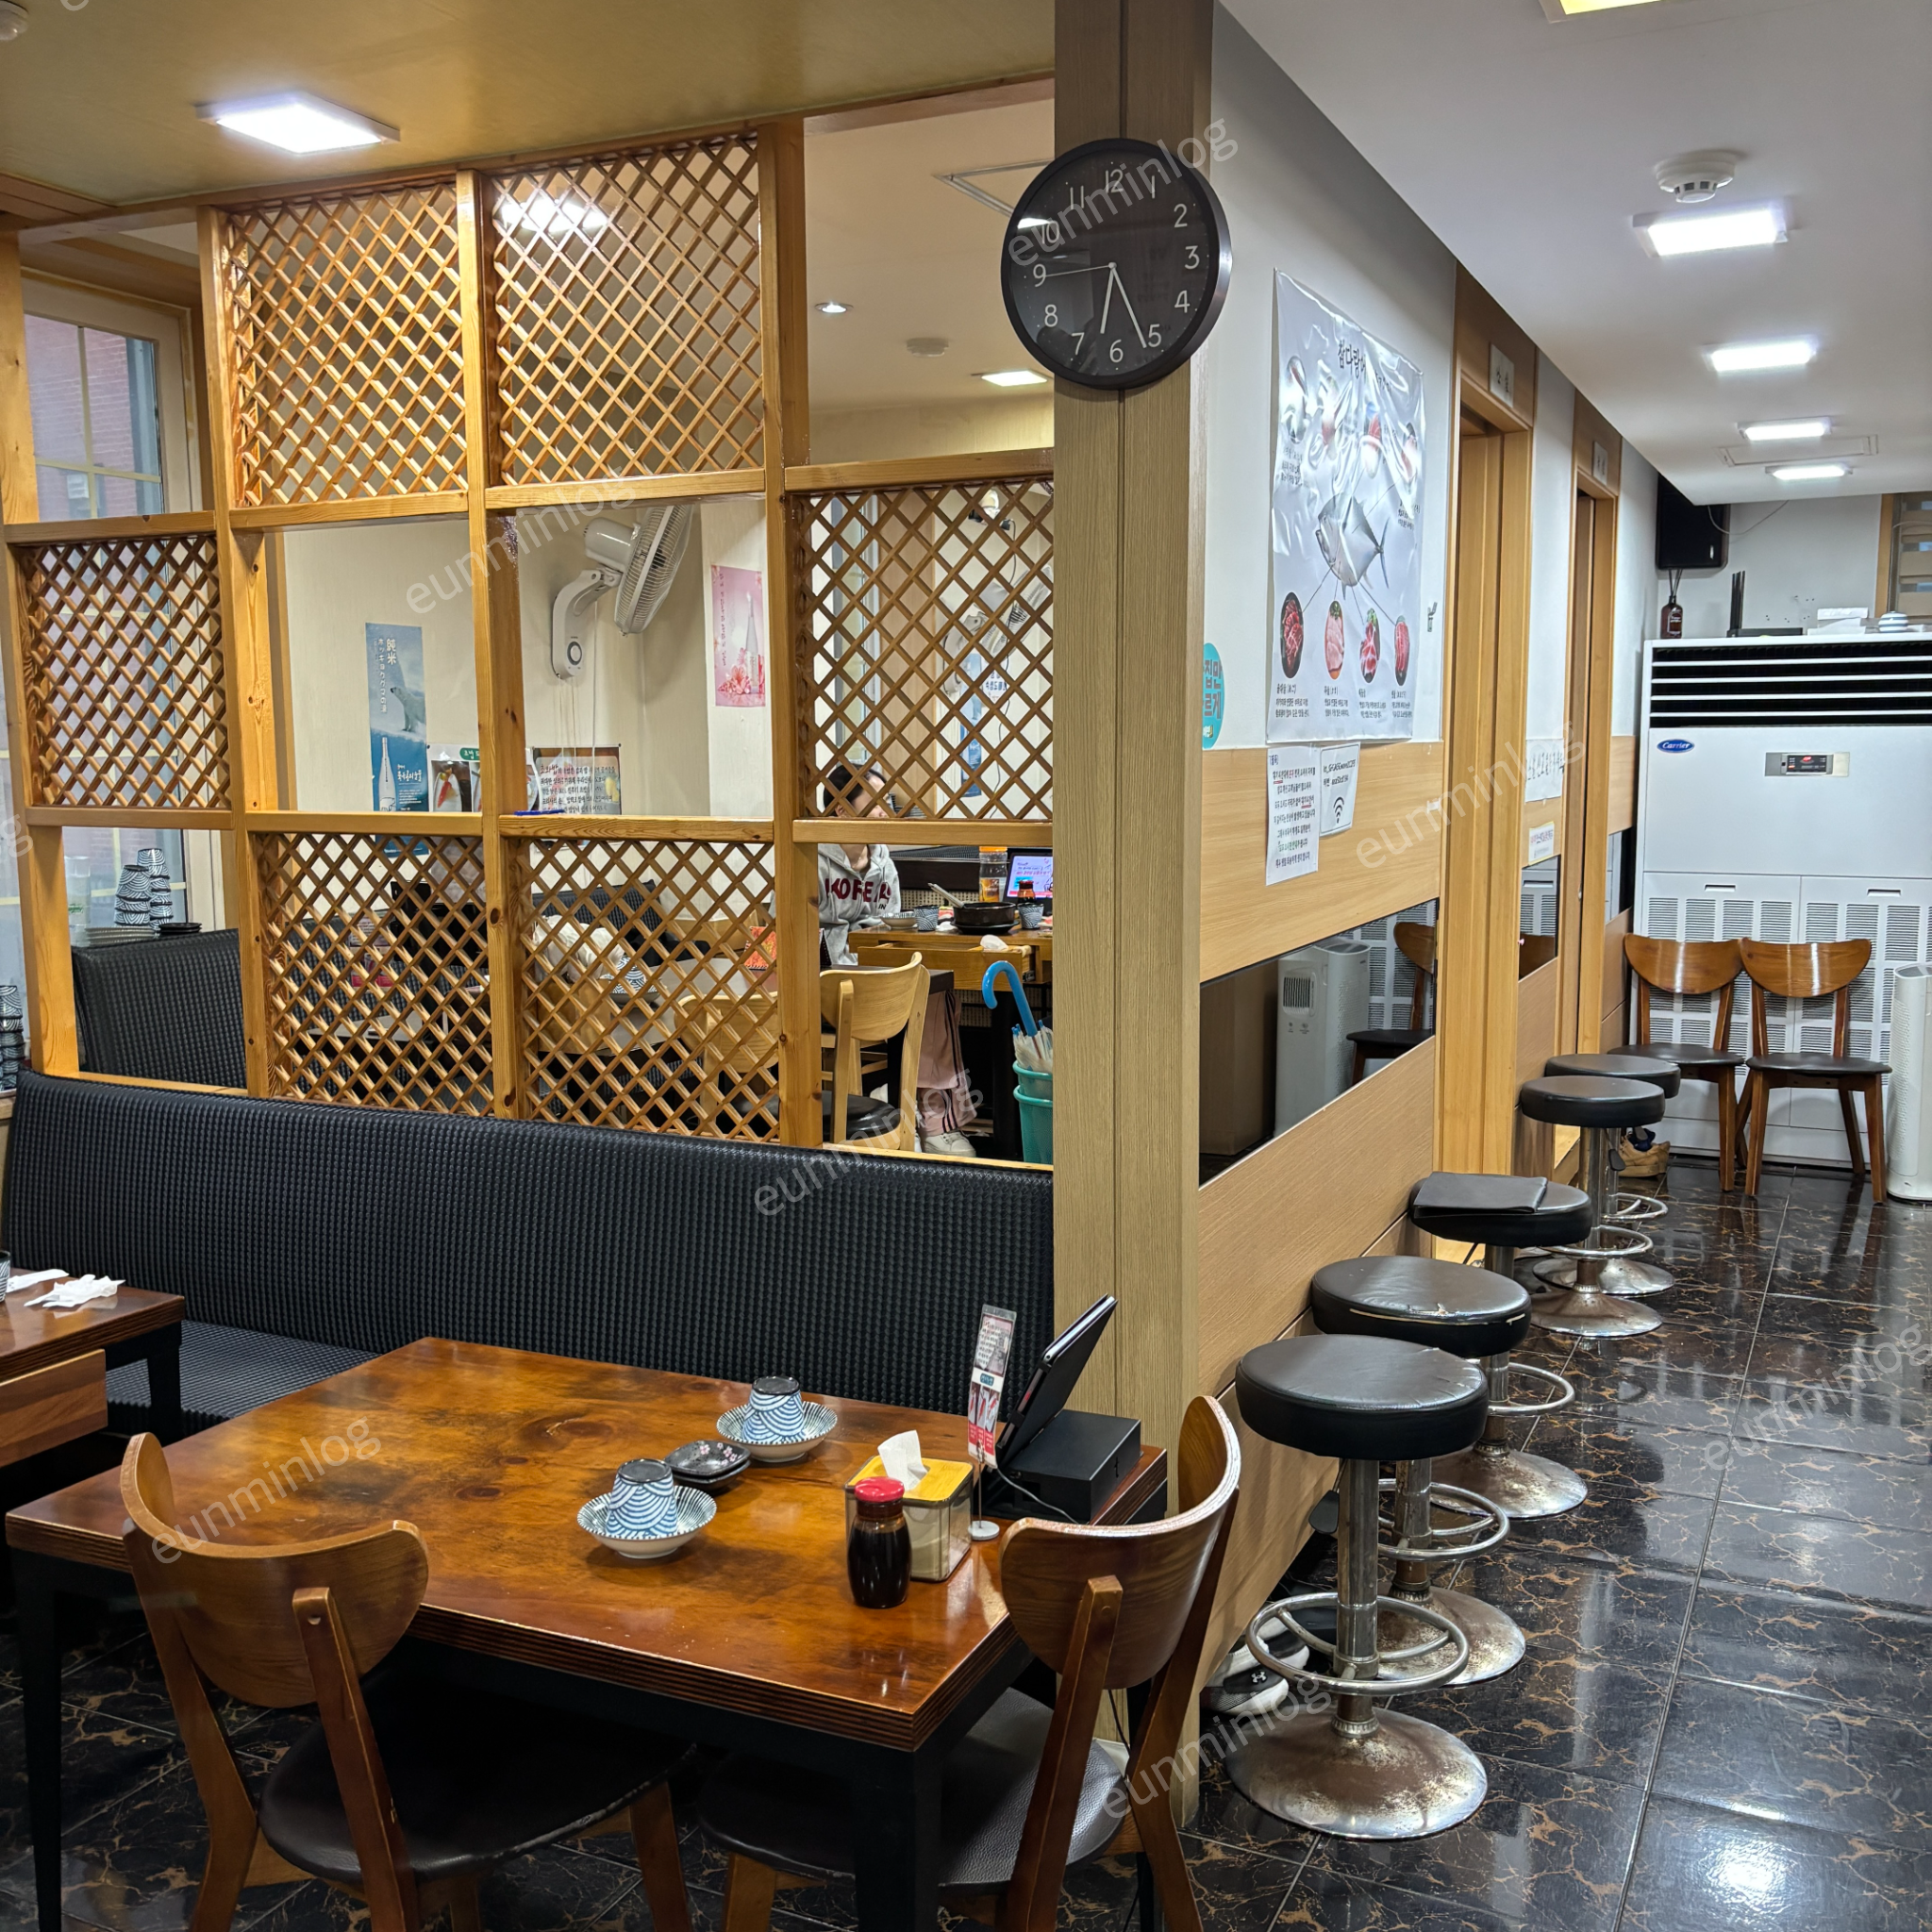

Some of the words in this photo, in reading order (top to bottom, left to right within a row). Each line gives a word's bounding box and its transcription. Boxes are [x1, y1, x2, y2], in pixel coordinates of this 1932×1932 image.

[1106, 169, 1124, 193] 12
[1151, 175, 1157, 199] 1
[1069, 185, 1085, 209] 11
[1174, 203, 1188, 228] 2
[1041, 220, 1060, 244] 10
[1184, 245, 1200, 270] 3
[1033, 264, 1047, 288] 9
[1174, 290, 1191, 313] 4
[1043, 304, 1058, 327] 8
[1071, 332, 1085, 356] 7
[1147, 324, 1162, 348] 5
[1109, 339, 1124, 363] 6
[1662, 741, 1690, 750] Carrier
